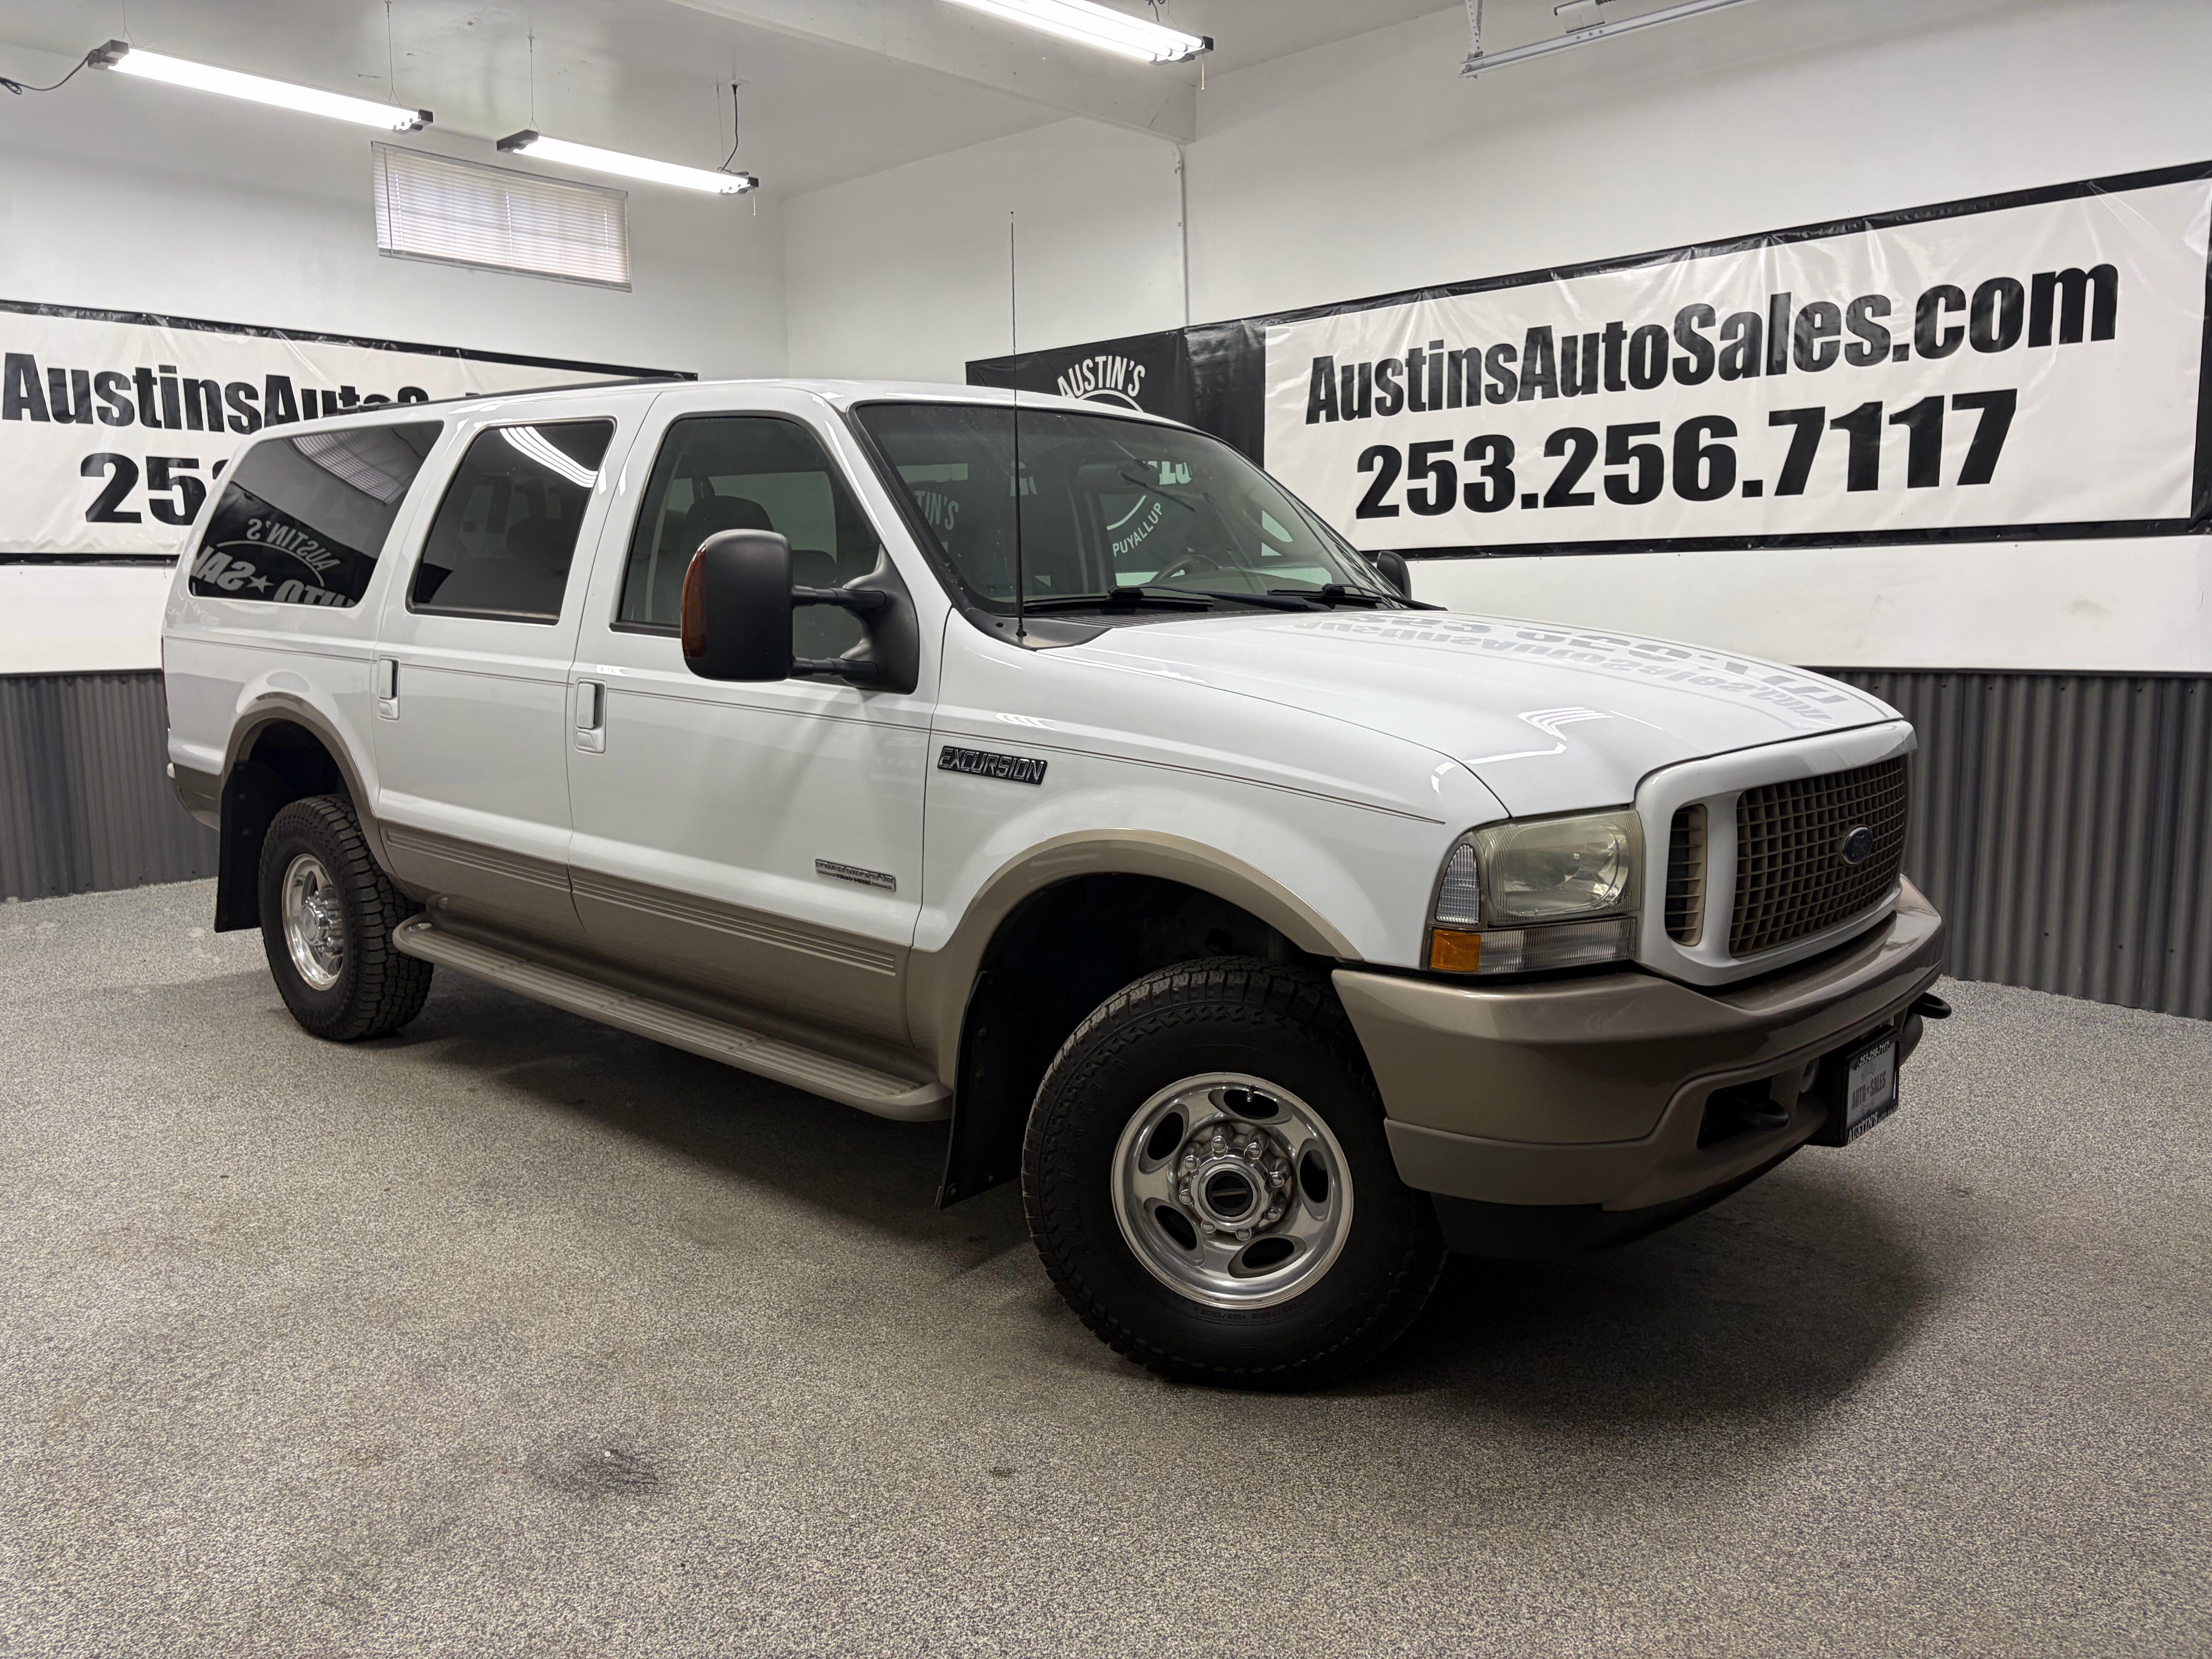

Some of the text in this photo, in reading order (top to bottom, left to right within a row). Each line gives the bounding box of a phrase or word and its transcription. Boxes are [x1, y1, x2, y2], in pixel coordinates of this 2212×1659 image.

[1305, 264, 2119, 425] AustinsAutoSales.com
[2, 352, 429, 434] AustinsAut
[1057, 356, 1146, 399] AUSTIN'S
[1356, 388, 2018, 519] 253.256.7117
[81, 452, 230, 526] 25
[1113, 503, 1162, 557] PUYALLUP
[938, 748, 1044, 782] EXCURSION
[1852, 1084, 1867, 1111] AUTO
[1870, 1070, 1886, 1097] SALES
[1847, 1111, 1878, 1144] AUSTIN'S
